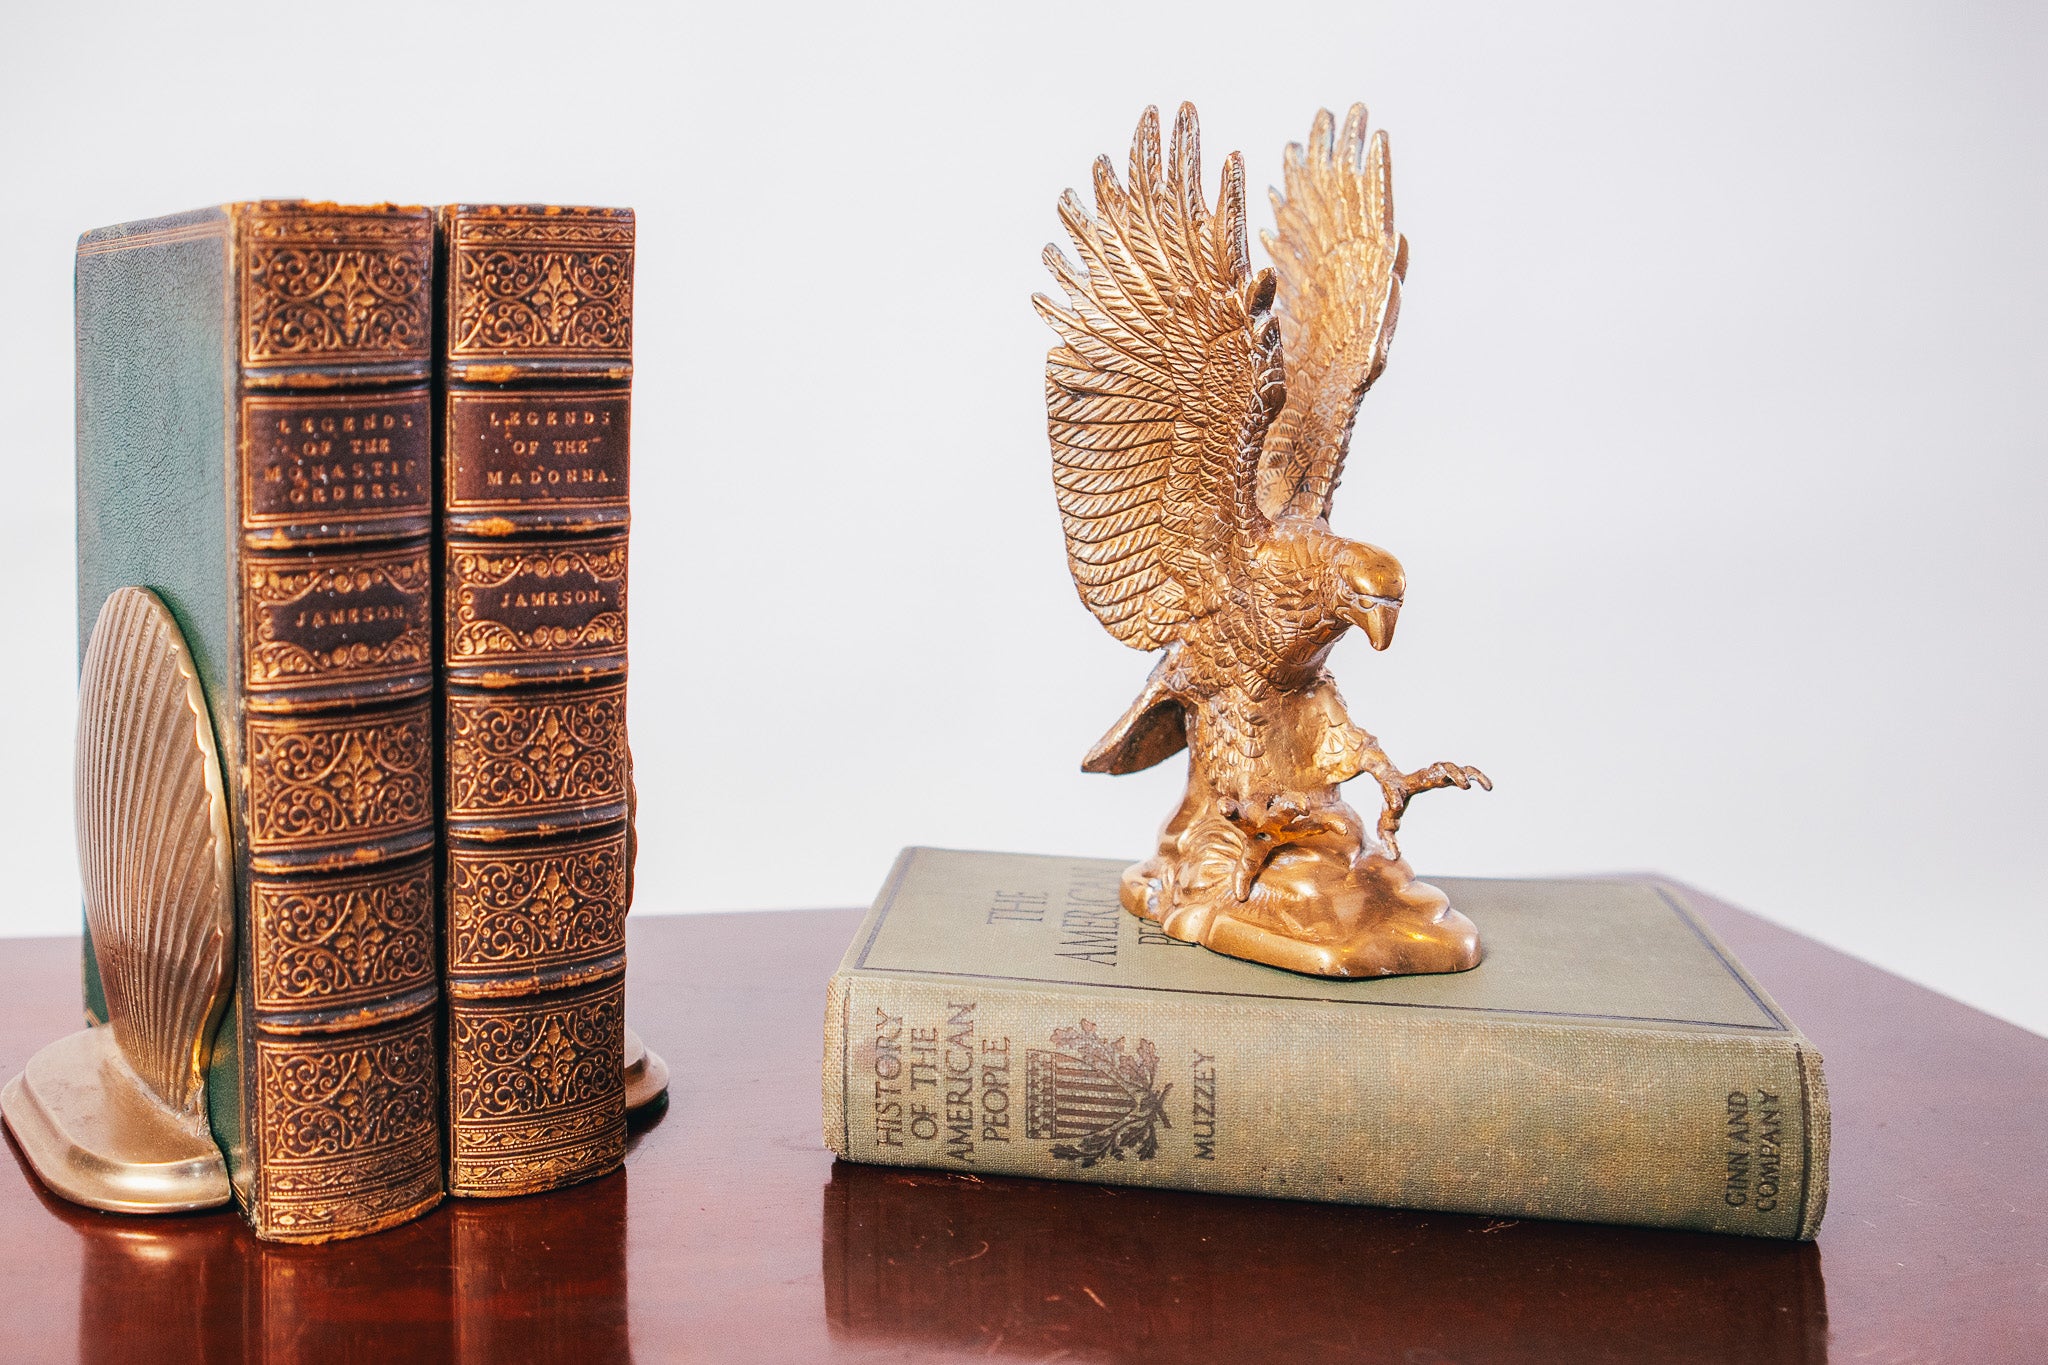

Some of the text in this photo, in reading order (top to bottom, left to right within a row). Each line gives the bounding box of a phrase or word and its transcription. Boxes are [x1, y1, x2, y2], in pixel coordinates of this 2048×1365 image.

[278, 413, 413, 434] LEGENDS
[490, 411, 611, 427] LEGENDS
[303, 438, 390, 456] OF THE
[513, 440, 588, 455] OF THE
[264, 460, 416, 482] MONASTIC
[486, 469, 616, 485] MADONNA.
[500, 590, 606, 608] JAMESON.
[986, 890, 1048, 925] THE
[875, 1007, 903, 1146] HISTORY
[911, 1027, 938, 1140] OF THE
[946, 1002, 976, 1164] AMERICAN
[982, 1036, 1010, 1144] PEOPLE
[1193, 1049, 1216, 1160] MUZZEY
[1725, 1091, 1749, 1206] GINN AND
[1756, 1089, 1781, 1212] COMPANY
